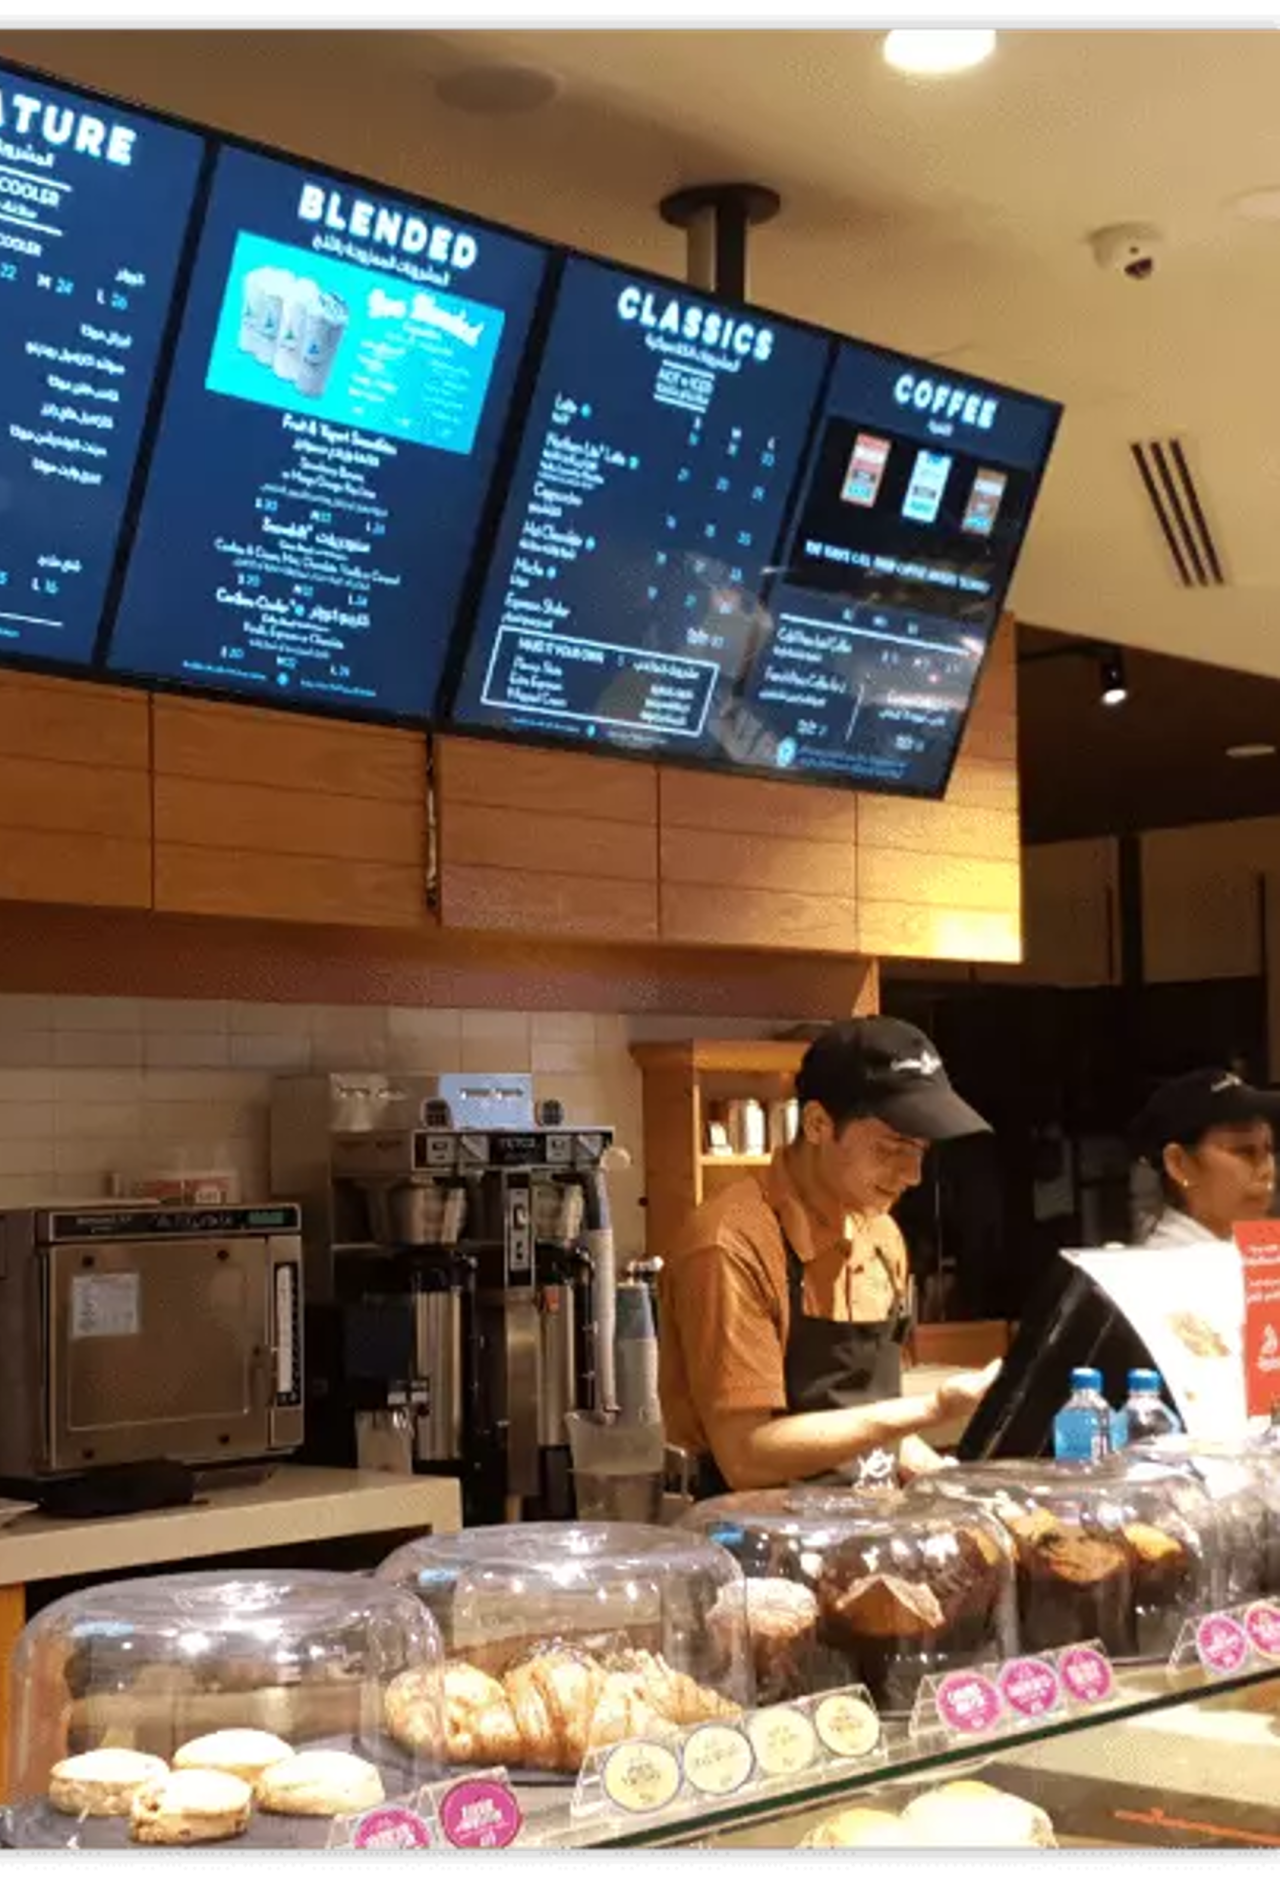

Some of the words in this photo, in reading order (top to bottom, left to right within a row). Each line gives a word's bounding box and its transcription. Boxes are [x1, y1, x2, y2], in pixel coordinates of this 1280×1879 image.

[297, 183, 479, 270] BLENDED
[618, 286, 775, 362] CLASSICS
[894, 372, 1000, 430] COFFEE
